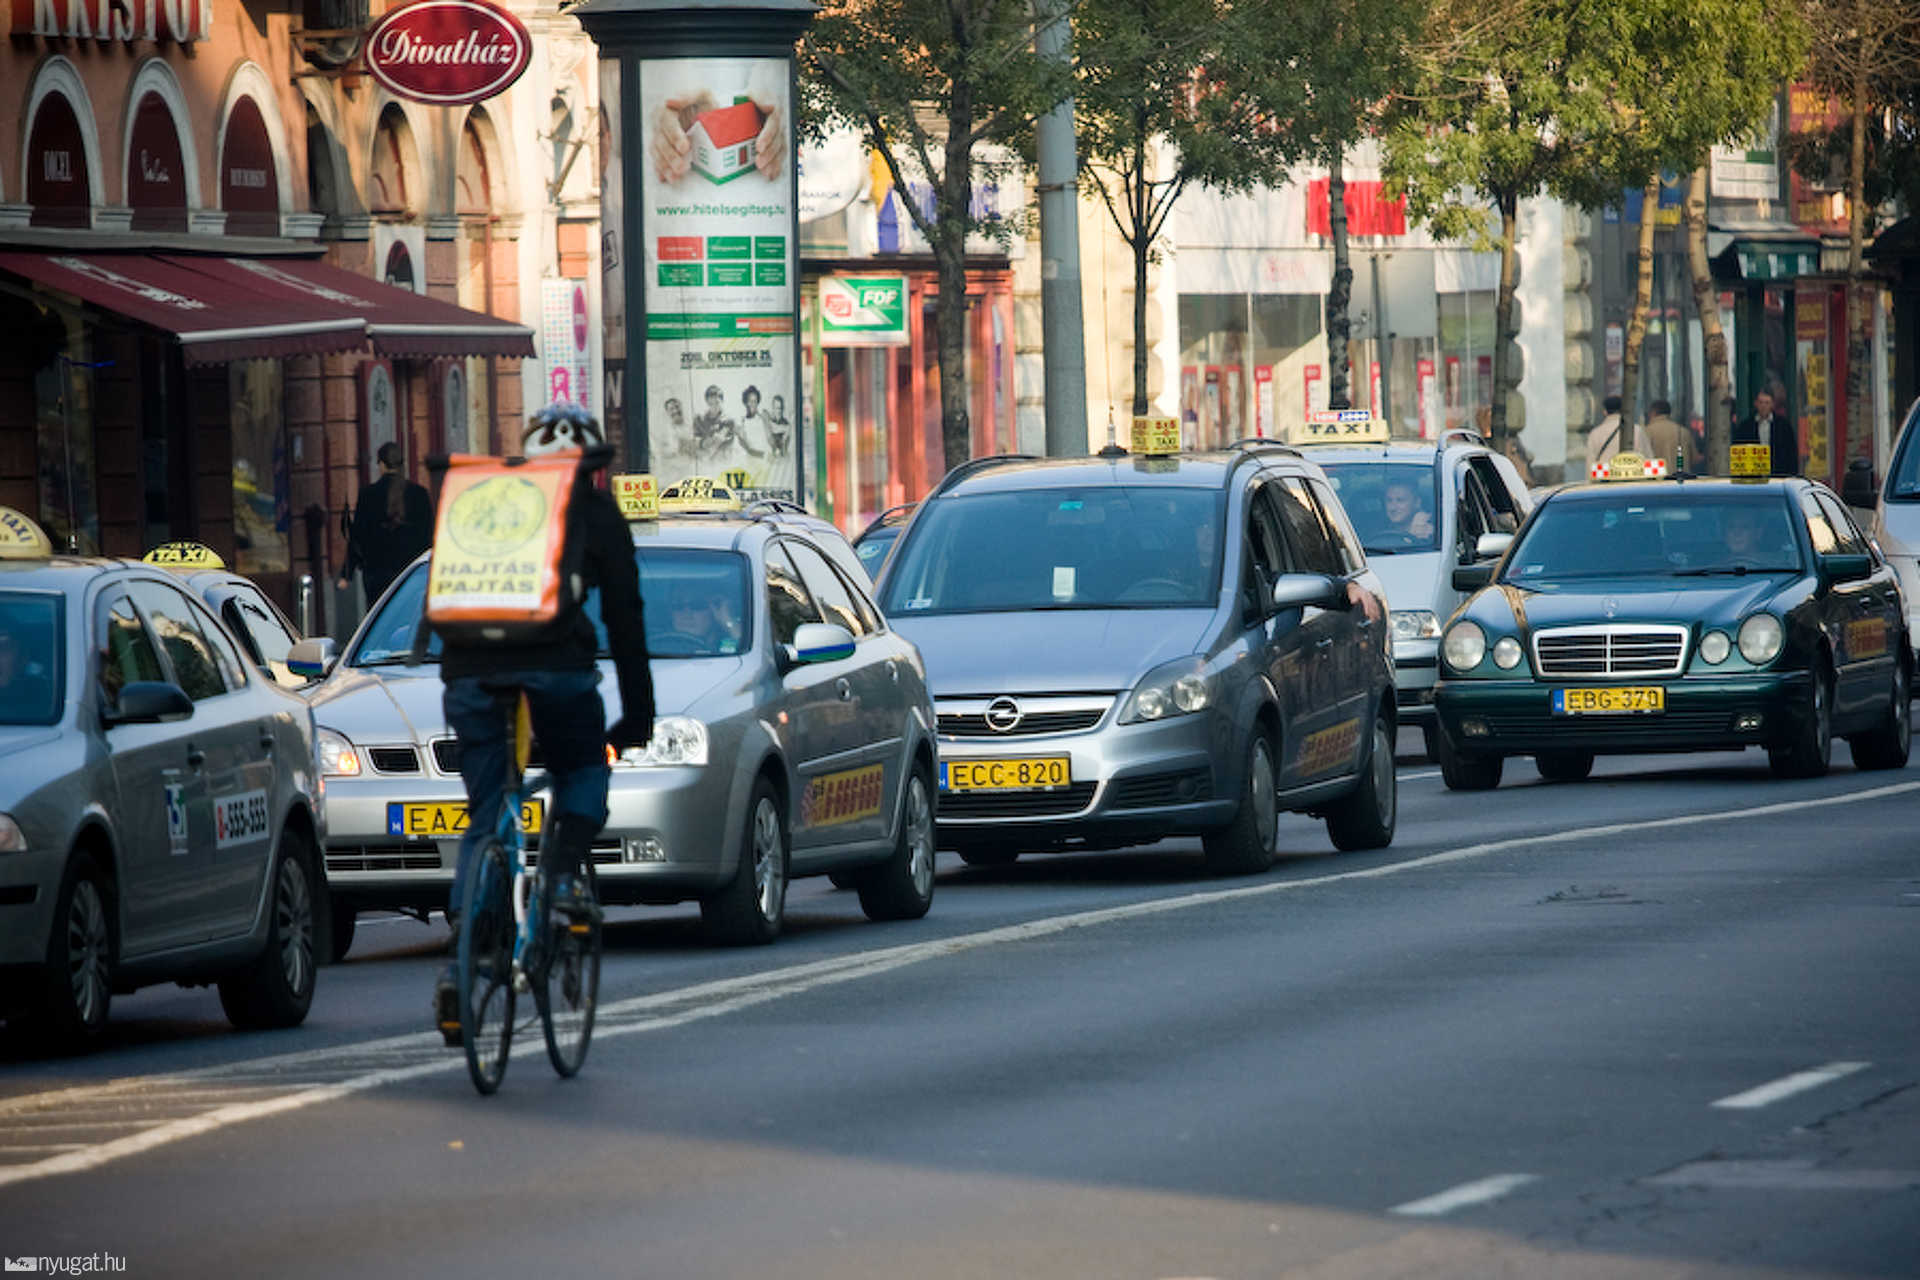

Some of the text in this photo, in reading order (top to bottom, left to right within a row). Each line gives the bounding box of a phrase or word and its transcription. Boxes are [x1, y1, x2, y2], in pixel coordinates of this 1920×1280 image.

[379, 28, 514, 64] Divatház
[1307, 424, 1371, 435] TAXI
[625, 500, 652, 511] TAXI
[1, 513, 33, 543] TAXI
[152, 549, 207, 562] TAXI
[440, 561, 537, 576] HAJTÁS
[437, 577, 535, 593] PAJTÁS
[1568, 690, 1659, 710] EBG-370
[952, 761, 1063, 786] ECC-820
